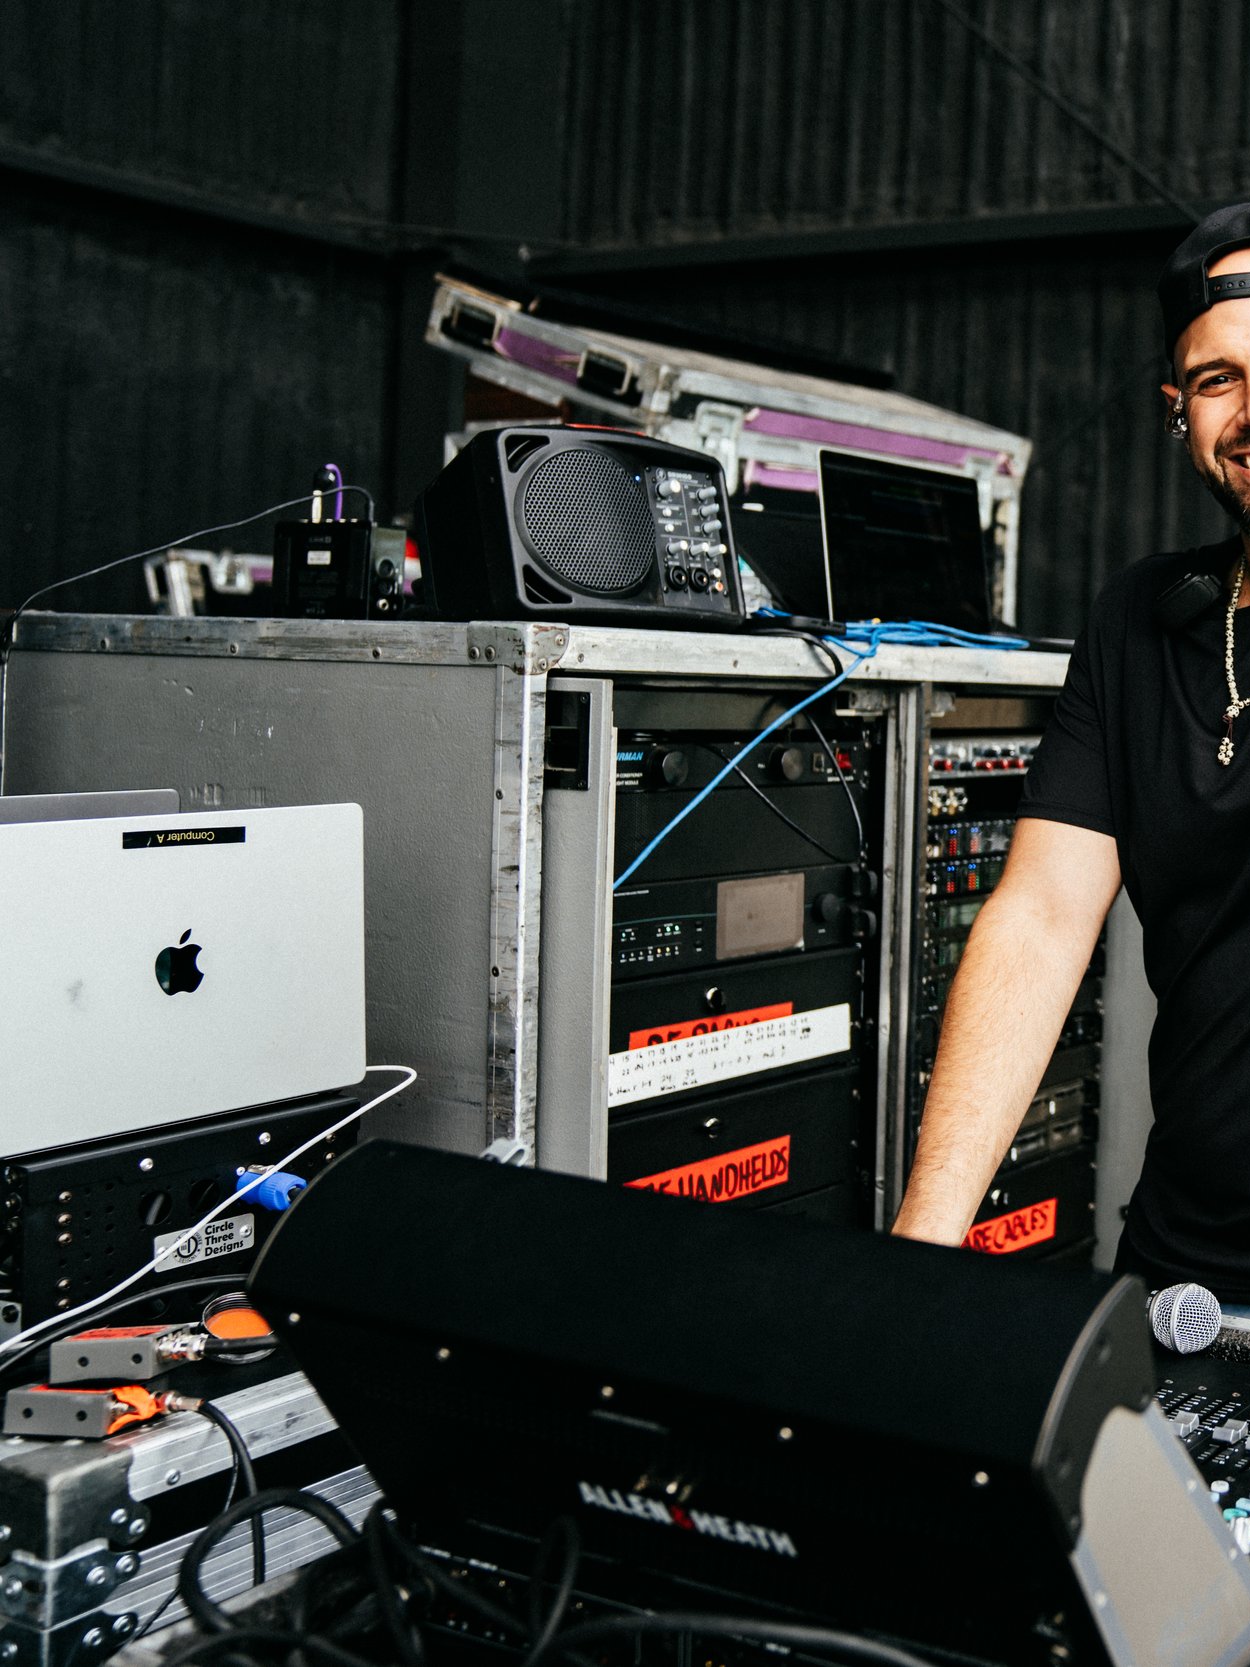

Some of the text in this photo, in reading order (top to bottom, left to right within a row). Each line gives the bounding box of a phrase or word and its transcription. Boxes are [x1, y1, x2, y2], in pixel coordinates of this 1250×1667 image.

[156, 831, 215, 844] Computer A
[677, 1146, 788, 1200] HANDHELDS
[204, 1221, 234, 1236] Circle
[204, 1232, 234, 1246] Three
[204, 1240, 244, 1257] Designs
